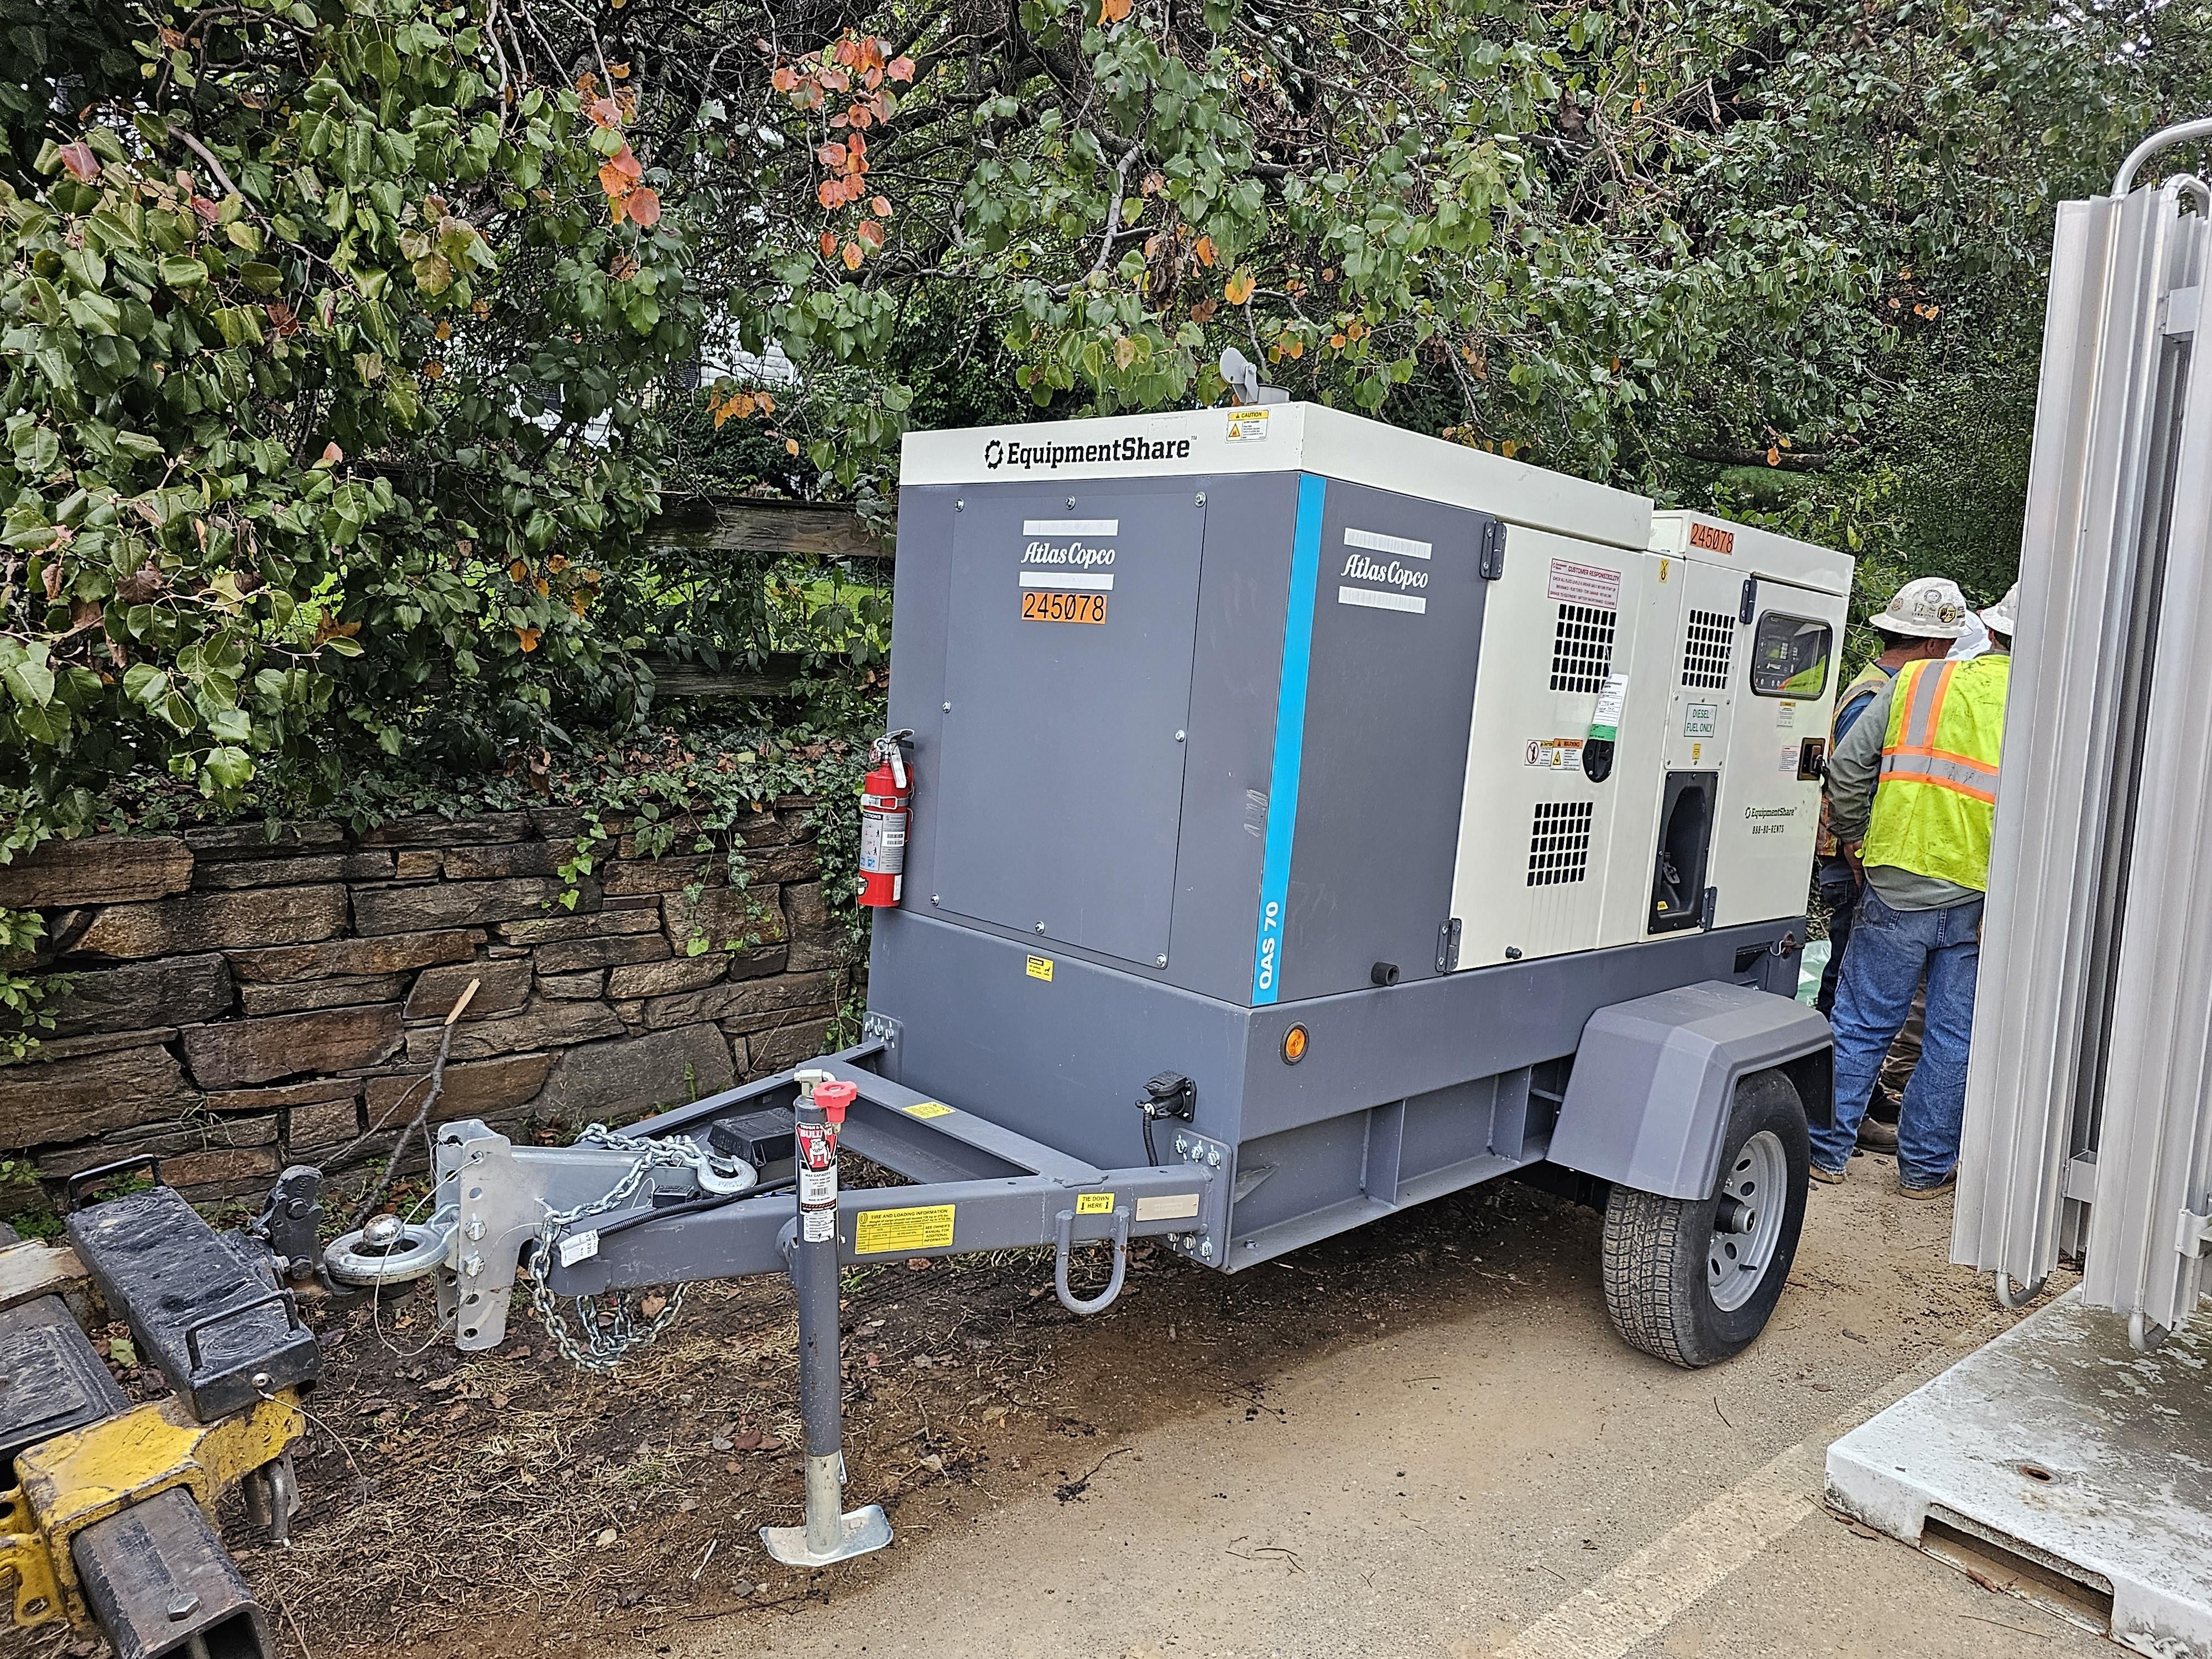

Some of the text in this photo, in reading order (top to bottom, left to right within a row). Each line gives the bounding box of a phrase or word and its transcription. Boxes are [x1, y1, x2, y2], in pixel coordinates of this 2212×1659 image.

[1006, 437, 1190, 469] EquipmentShare
[1690, 523, 1734, 554] 245078
[1568, 566, 1619, 582] CUSTOMER RESPONSIBILITY
[1023, 593, 1104, 622] 245078
[1693, 709, 1709, 718] DIESEL
[1686, 723, 1713, 732] FUEL ONLY
[1751, 807, 1794, 819] EquipmentShare
[1259, 901, 1279, 990] QAS 70
